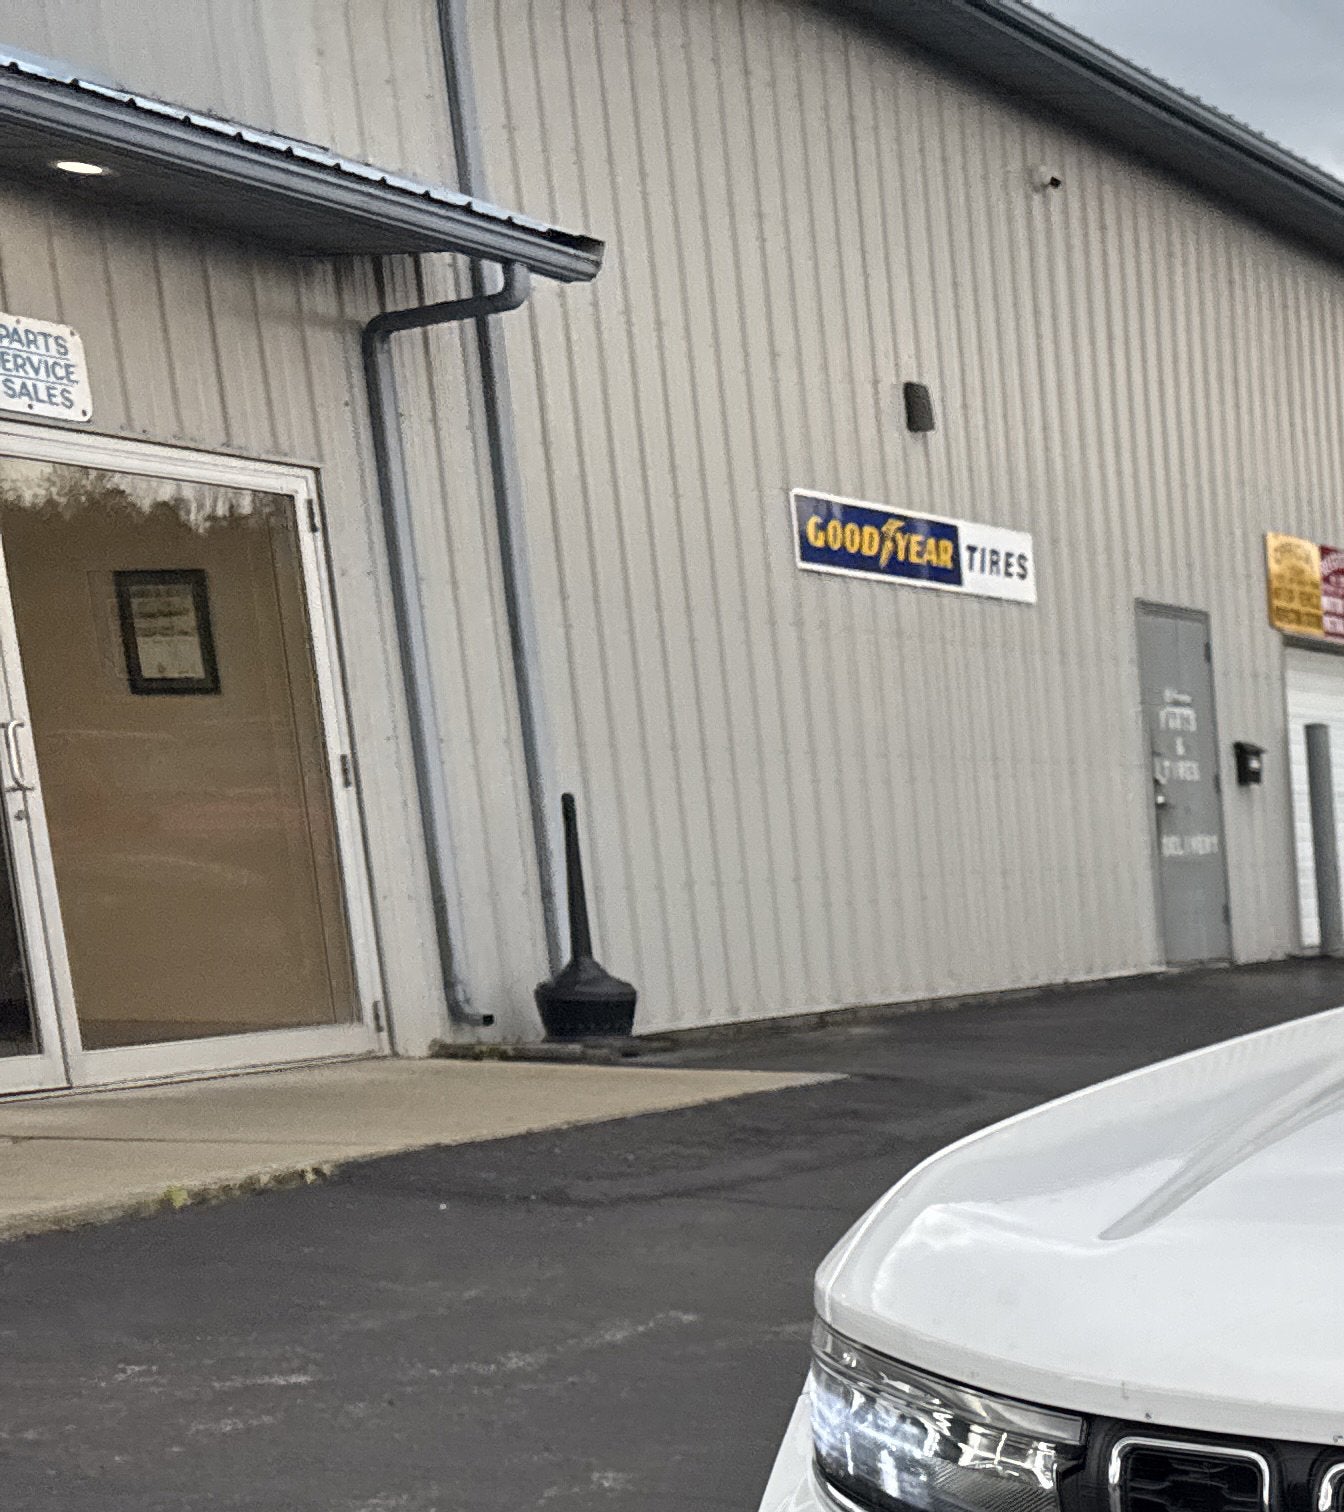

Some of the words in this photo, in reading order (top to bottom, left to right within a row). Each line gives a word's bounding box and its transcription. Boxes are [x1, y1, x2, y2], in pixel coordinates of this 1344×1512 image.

[0, 323, 69, 357] PARTS
[0, 350, 78, 385] ERVICE
[2, 377, 74, 410] SALES
[805, 514, 954, 570] GOODYEAR
[966, 544, 1029, 581] TIRES
